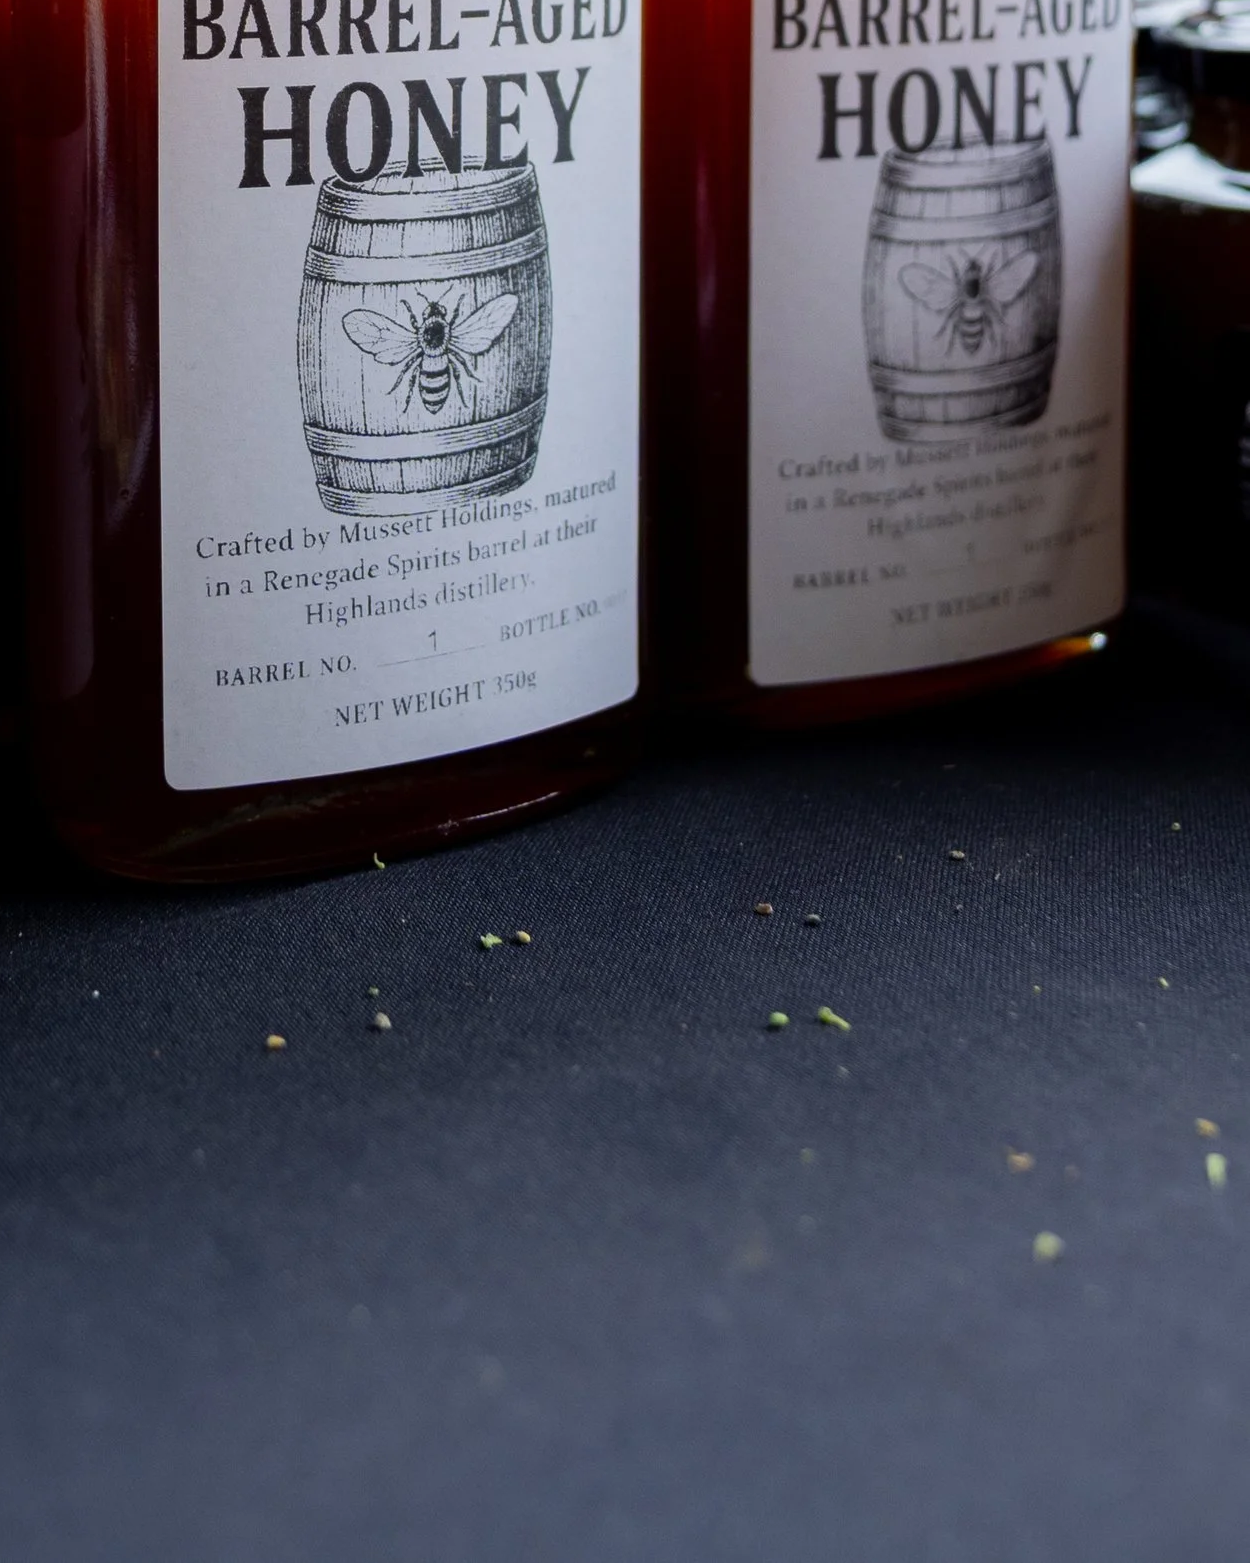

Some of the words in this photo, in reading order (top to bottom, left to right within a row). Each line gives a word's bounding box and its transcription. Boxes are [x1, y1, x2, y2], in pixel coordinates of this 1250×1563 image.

[236, 66, 592, 188] HONEY
[816, 54, 1093, 160] HONEY
[196, 535, 295, 560] Crafted
[302, 529, 331, 551] by
[340, 515, 434, 545] Mussett
[544, 471, 618, 508] matured
[205, 575, 231, 598] in
[240, 577, 254, 595] a
[263, 559, 381, 592] Renegade
[386, 547, 462, 581] Spirits
[467, 530, 527, 562] barrel
[533, 527, 552, 550] at
[556, 514, 599, 545] their
[215, 661, 311, 687] BARREL
[319, 654, 358, 676] NO.
[500, 606, 571, 642] BOTTLE
[305, 589, 428, 627] Highlands
[335, 700, 385, 728] NET
[391, 679, 486, 718] WEIGHT
[493, 669, 538, 696] 350g
